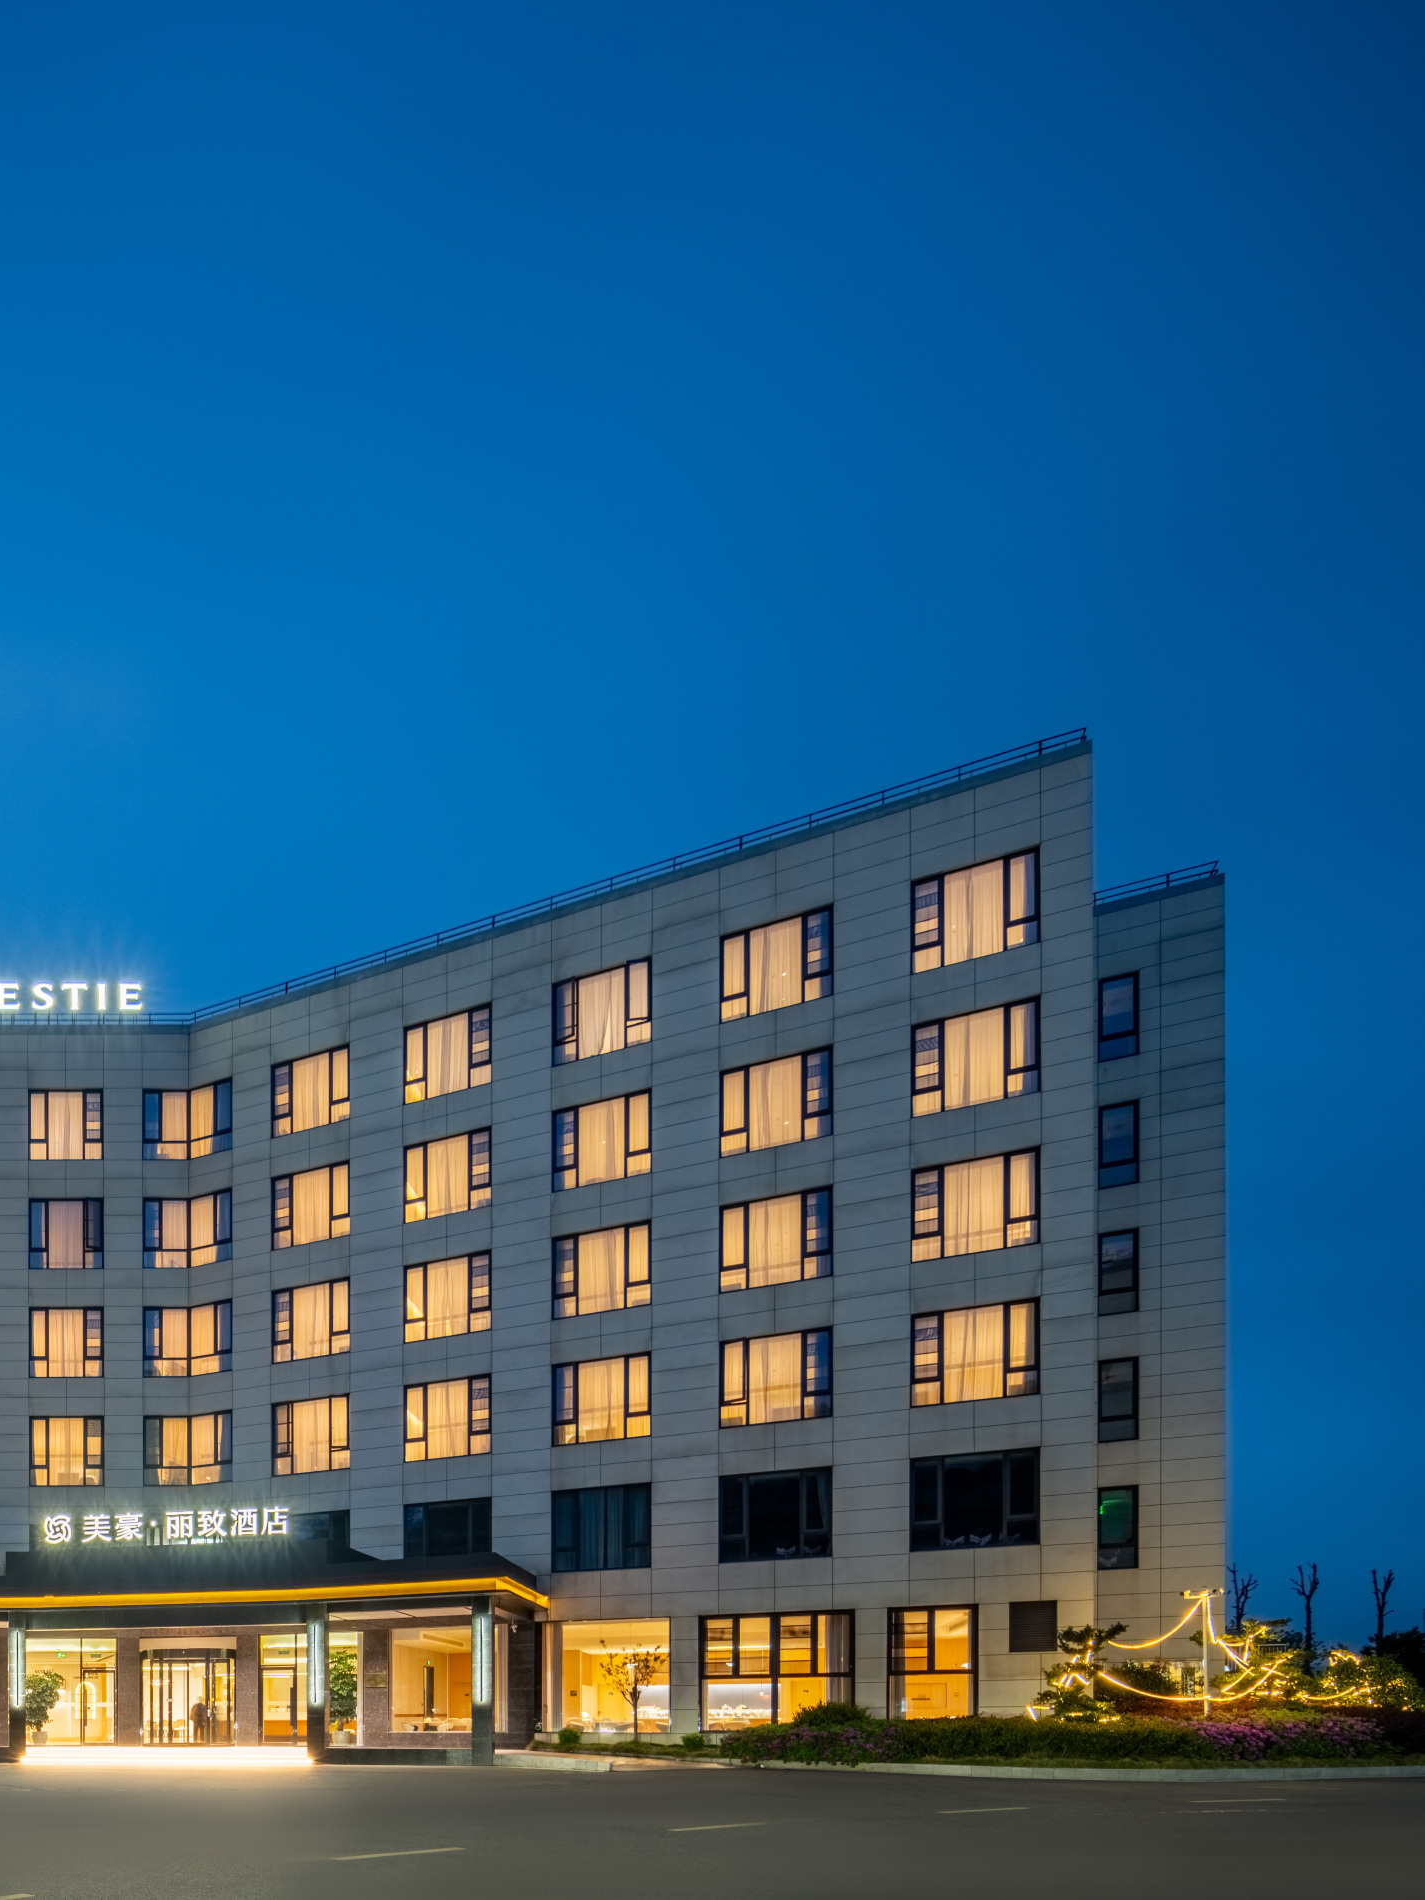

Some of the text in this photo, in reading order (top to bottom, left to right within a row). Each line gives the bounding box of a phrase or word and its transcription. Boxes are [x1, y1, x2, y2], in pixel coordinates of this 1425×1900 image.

[81, 1506, 290, 1543] 美豪·丽致酒店
